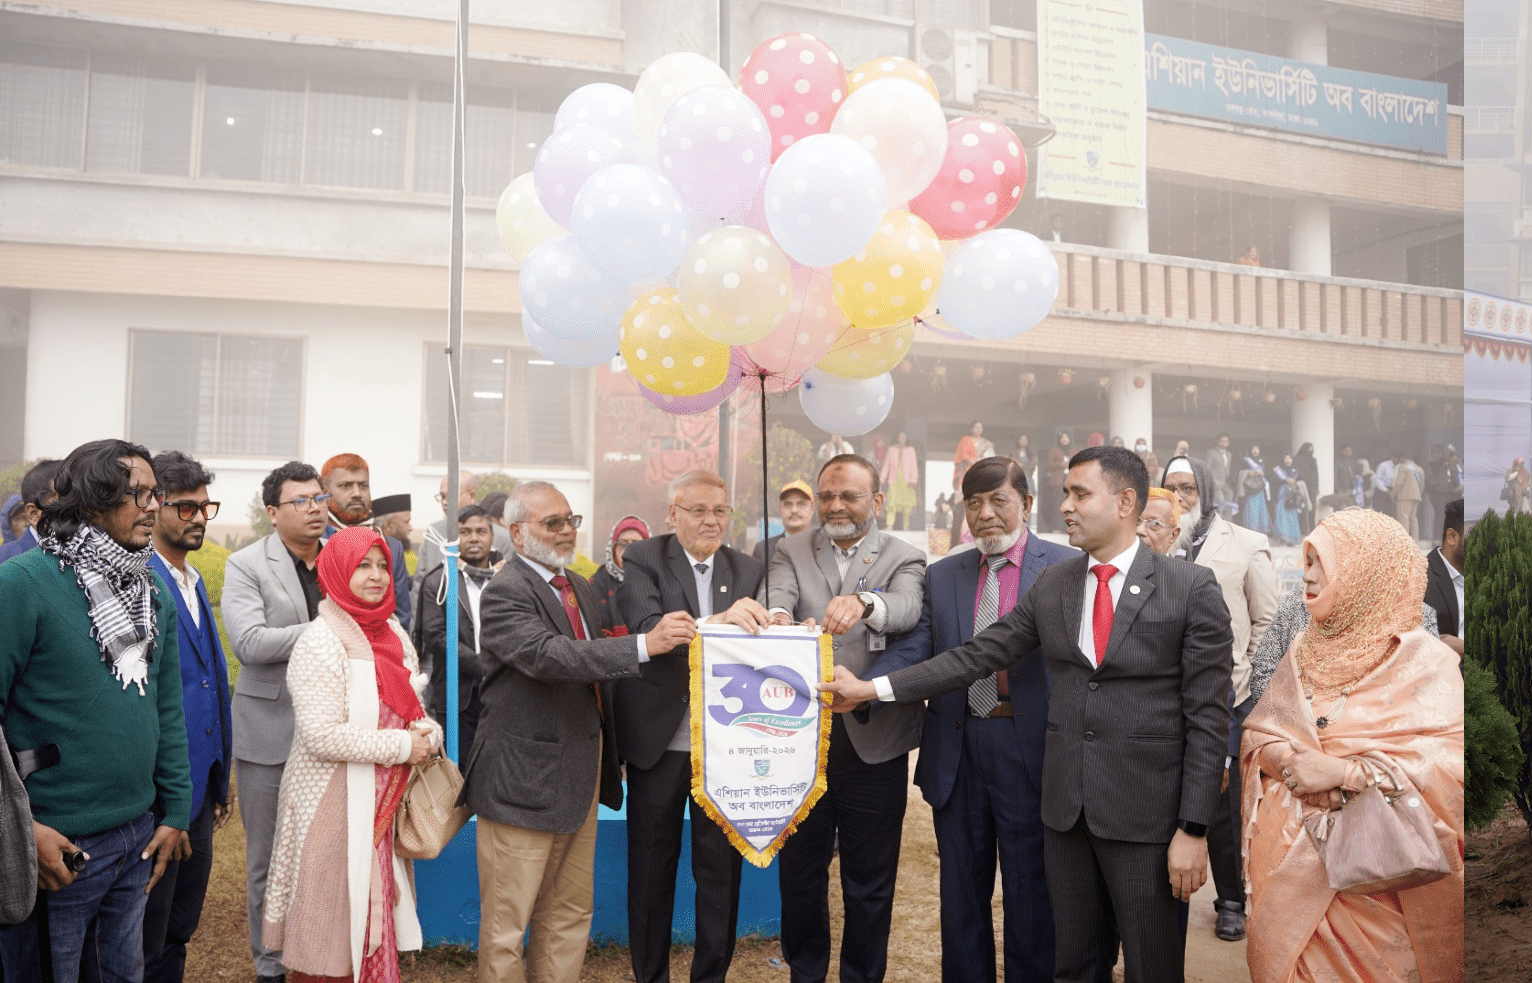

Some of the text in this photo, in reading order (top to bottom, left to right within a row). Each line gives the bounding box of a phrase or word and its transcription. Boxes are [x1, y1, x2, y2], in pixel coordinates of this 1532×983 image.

[1211, 52, 1319, 107] ইউনিভার্সিটি
[1322, 81, 1354, 116] অব
[1358, 86, 1440, 127] বাংলাদেশ
[708, 664, 811, 726] 30
[762, 686, 794, 699] AUB
[763, 717, 770, 725] of
[714, 782, 807, 798] এশিয়ান ইউনিভার্সিটি
[728, 799, 794, 812] অব বাংলাদেশ
